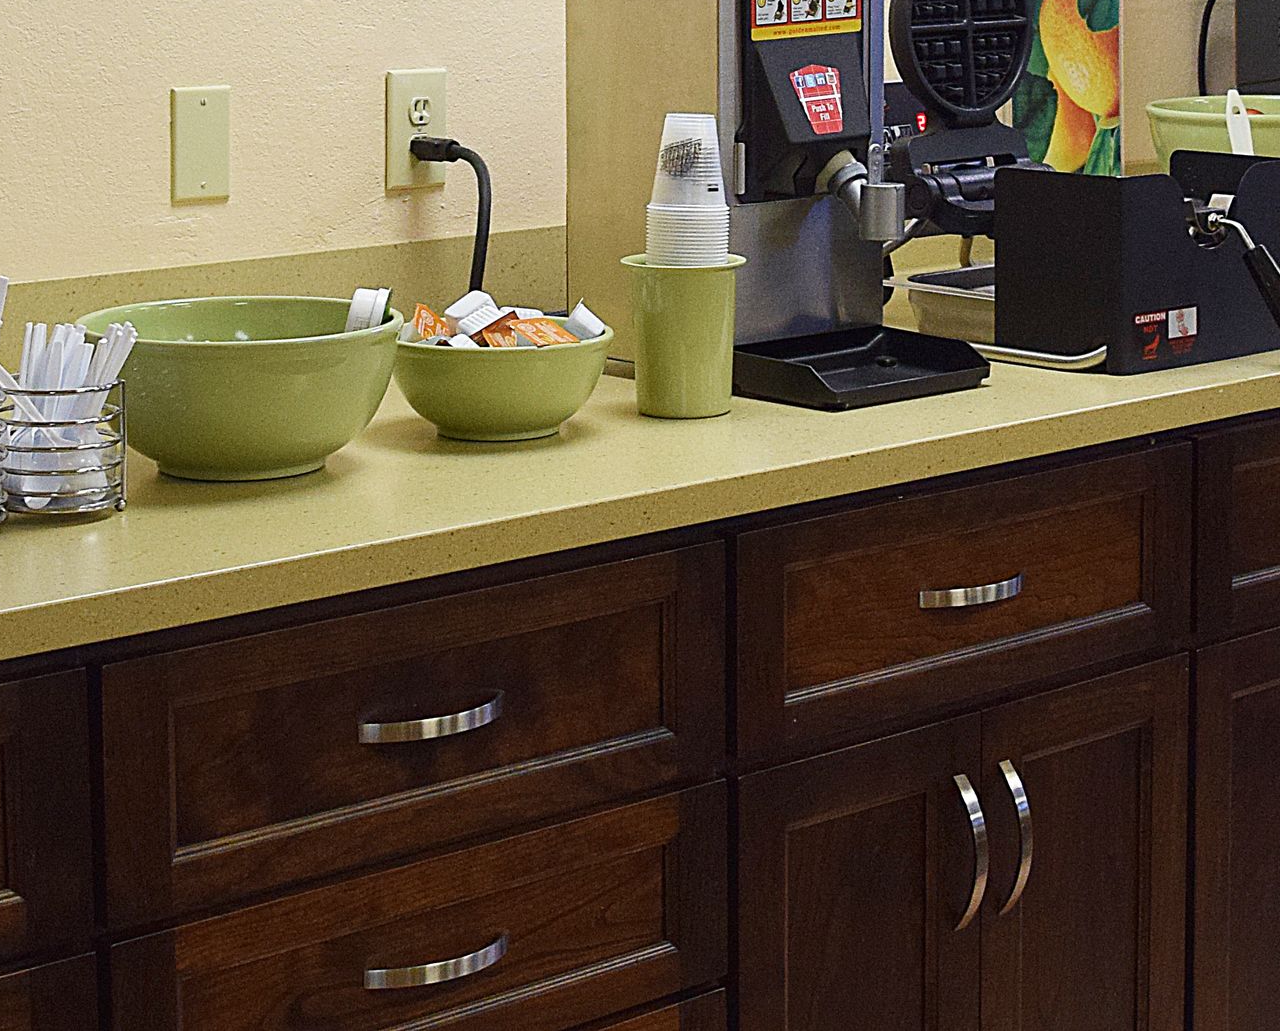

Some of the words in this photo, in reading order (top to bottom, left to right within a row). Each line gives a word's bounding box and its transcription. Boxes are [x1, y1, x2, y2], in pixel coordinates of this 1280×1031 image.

[811, 104, 826, 113] Push
[826, 102, 834, 110] To
[1135, 311, 1166, 324] CAUTION
